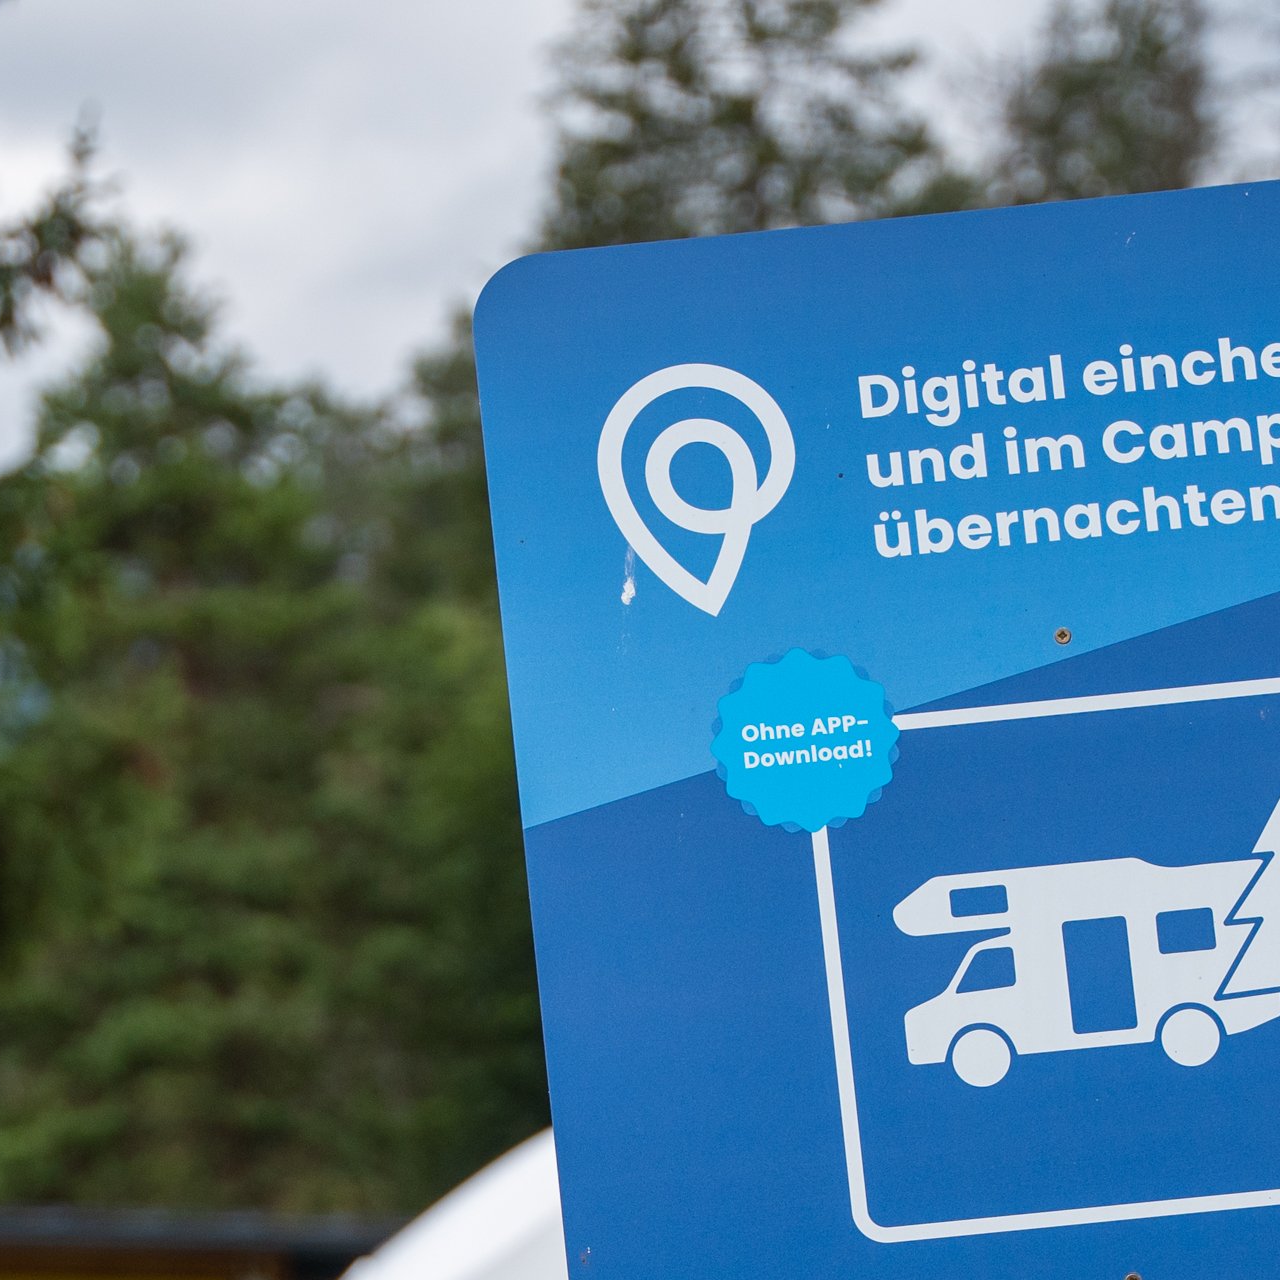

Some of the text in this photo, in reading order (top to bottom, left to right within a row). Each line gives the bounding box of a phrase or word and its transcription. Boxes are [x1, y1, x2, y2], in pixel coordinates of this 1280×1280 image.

[859, 355, 1065, 426] Digital
[867, 433, 987, 487] und
[1004, 427, 1085, 474] im
[742, 716, 868, 741] Ohne APP-
[744, 740, 871, 768] Download!
